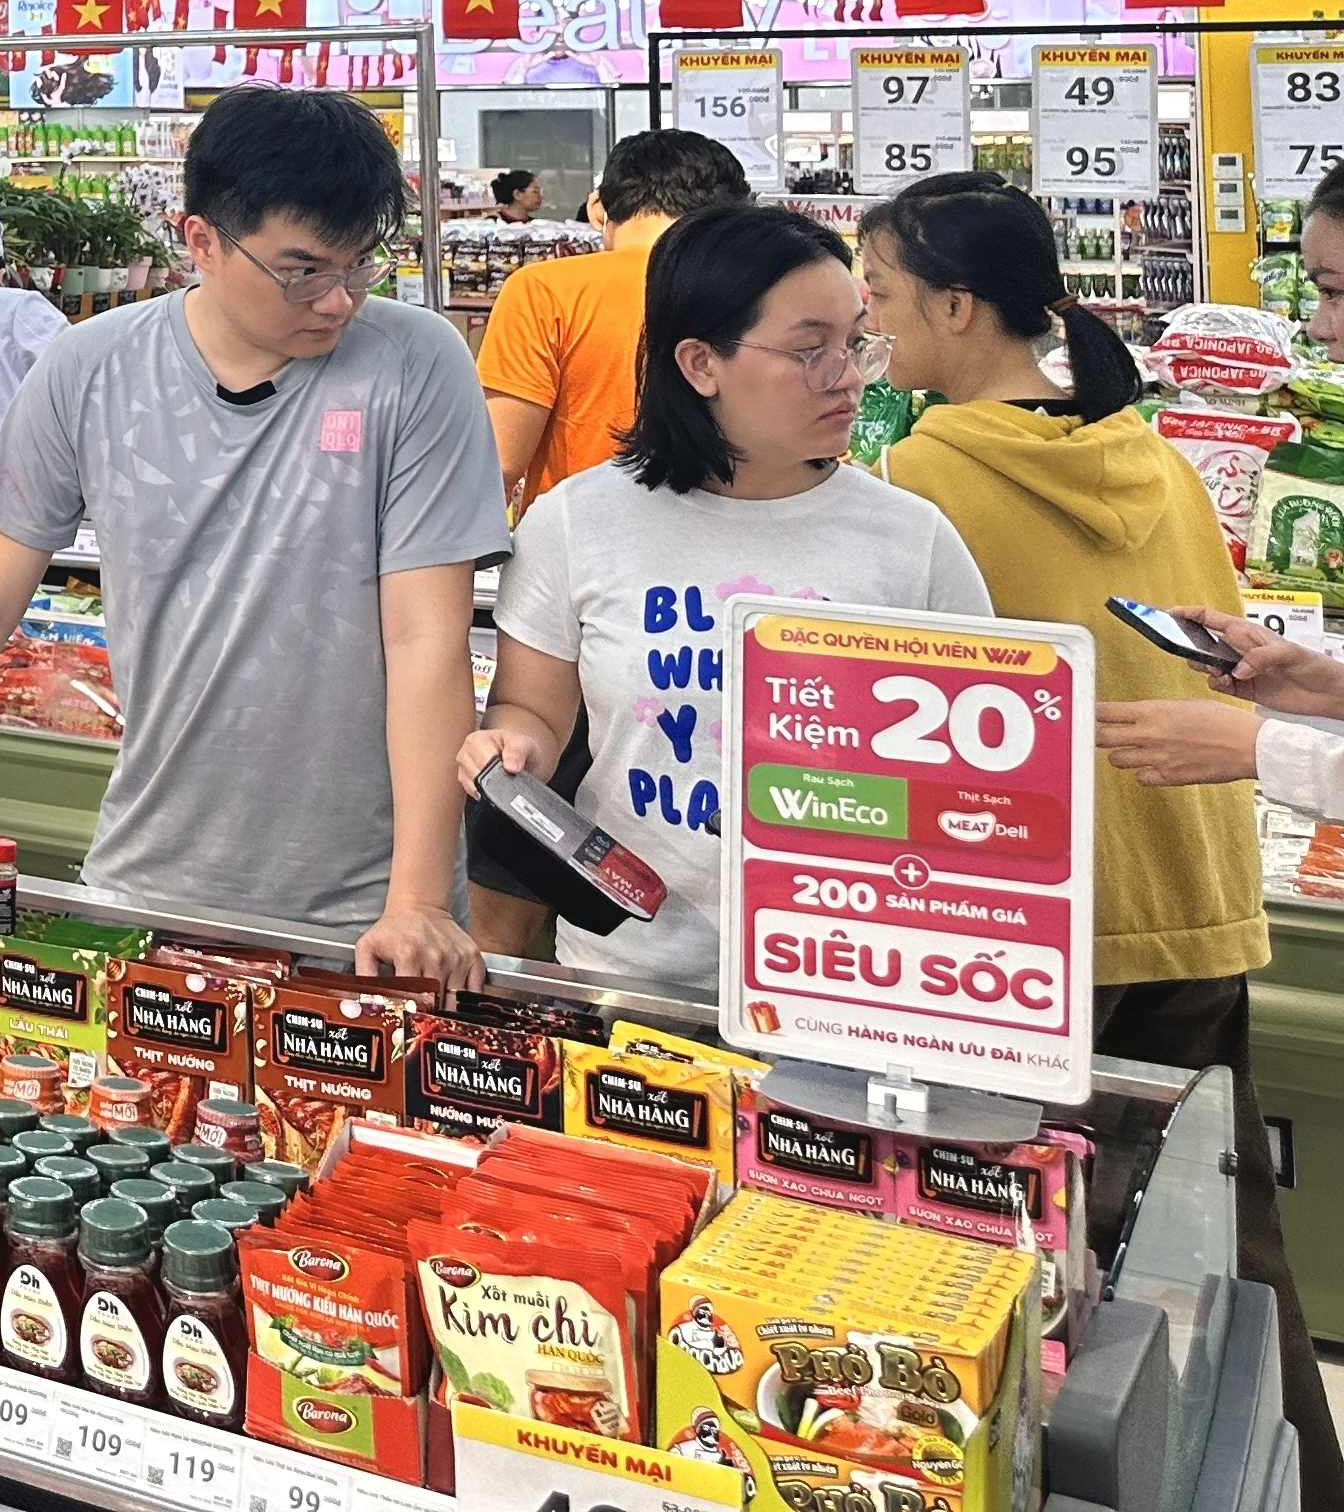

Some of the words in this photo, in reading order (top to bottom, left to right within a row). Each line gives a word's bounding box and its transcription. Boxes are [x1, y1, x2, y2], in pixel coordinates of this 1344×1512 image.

[17, 0, 54, 12] Rejoice
[860, 50, 916, 67] KHUYẾN
[920, 52, 960, 69] MẠI
[1040, 49, 1104, 66] KHUYẾN
[1109, 50, 1148, 67] MẠI
[882, 76, 930, 105] 97
[1064, 76, 1115, 107] 49
[1286, 73, 1341, 103] 83
[694, 95, 747, 119] 156
[884, 143, 933, 173] 85
[1066, 147, 1116, 177] 95
[1288, 144, 1343, 175] 75
[1179, 336, 1249, 354] JAPONICA
[780, 627, 819, 649] ĐẶC
[823, 625, 890, 654] QUYỀN
[893, 634, 930, 657] HỘI
[934, 637, 978, 661] VIÊN
[1033, 688, 1063, 721] %
[764, 674, 836, 711] Tiết
[870, 675, 1037, 772] 20
[768, 711, 860, 750] Kiệm
[802, 772, 824, 784] Rau
[827, 775, 854, 788] Sạch
[768, 785, 888, 827] WinEco
[957, 790, 980, 804] Thịt
[982, 792, 1012, 806] Sạch
[947, 816, 990, 834] MEAT
[995, 822, 1029, 840] Deli
[791, 874, 878, 913] 200
[884, 890, 926, 913] SẢN
[928, 893, 989, 923] PHẨM
[991, 905, 1028, 927] GIÁ
[3, 958, 36, 975] CHIN-SU
[763, 929, 903, 988] SIÊU
[919, 948, 1055, 1011] SỐC
[2, 975, 31, 998] NHÀ
[32, 979, 73, 1005] HÀNG
[794, 1013, 843, 1036] CÙNG
[847, 1023, 898, 1046] HÀNG
[903, 1031, 954, 1055] NGÀN
[958, 1039, 986, 1059] ƯU
[990, 1042, 1022, 1065] ĐÃI
[133, 1044, 165, 1065] THỊT
[168, 1048, 216, 1072] NƯỚNG
[250, 1274, 269, 1295] THỊT
[272, 1285, 311, 1308] NƯỚNG
[313, 1294, 336, 1317] KIỂU
[339, 1304, 362, 1324] HÀN
[365, 1309, 399, 1329] QUỐC
[438, 1283, 518, 1344] Kim
[532, 1296, 599, 1348] chi
[875, 1341, 961, 1404] BÒ
[299, 1399, 350, 1426] Barona
[168, 1451, 215, 1482] 119
[517, 1428, 618, 1469] KHUYẾN
[625, 1456, 673, 1484] MẠI
[288, 1486, 321, 1511] 99
